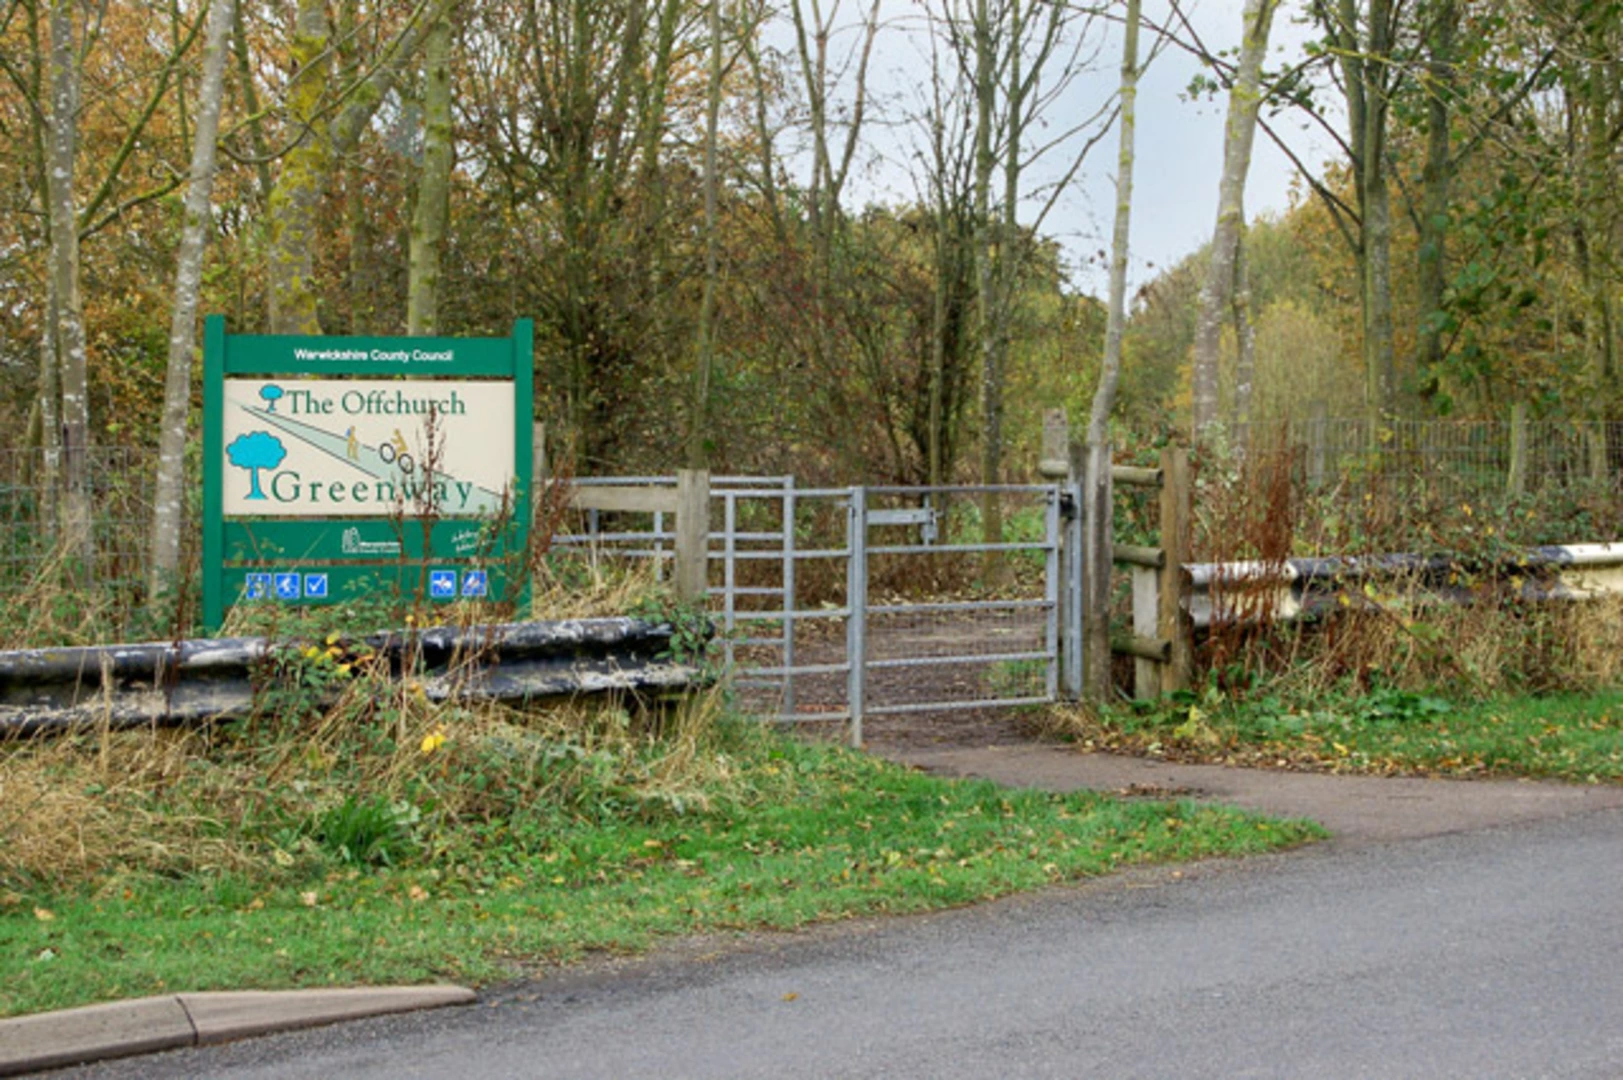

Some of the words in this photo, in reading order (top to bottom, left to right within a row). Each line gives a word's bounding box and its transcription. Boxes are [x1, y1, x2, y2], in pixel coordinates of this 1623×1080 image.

[294, 349, 368, 361] Warwickshire
[370, 349, 409, 363] County
[412, 349, 454, 361] Council
[286, 390, 334, 414] The
[341, 390, 466, 414] Offchurch
[271, 470, 472, 508] Greenway
